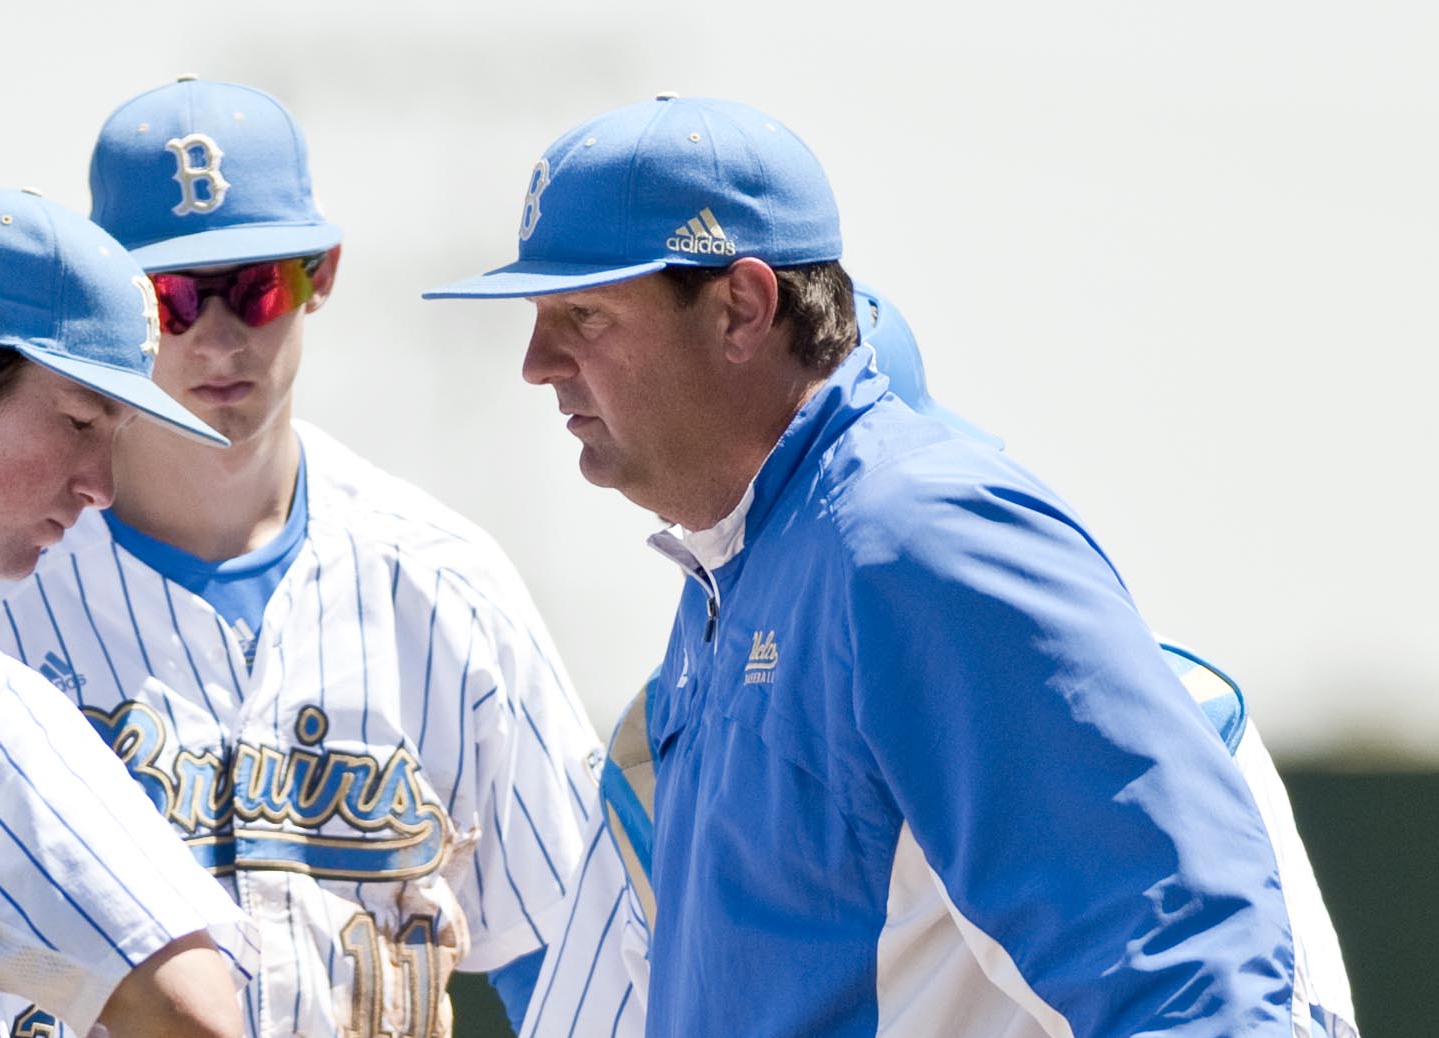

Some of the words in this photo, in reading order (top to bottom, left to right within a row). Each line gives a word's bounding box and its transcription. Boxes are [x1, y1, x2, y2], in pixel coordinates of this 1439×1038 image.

[164, 133, 231, 216] B
[518, 158, 550, 240] B
[666, 234, 736, 257] adidas
[745, 630, 778, 671] Ucla
[79, 700, 448, 882] Bruins
